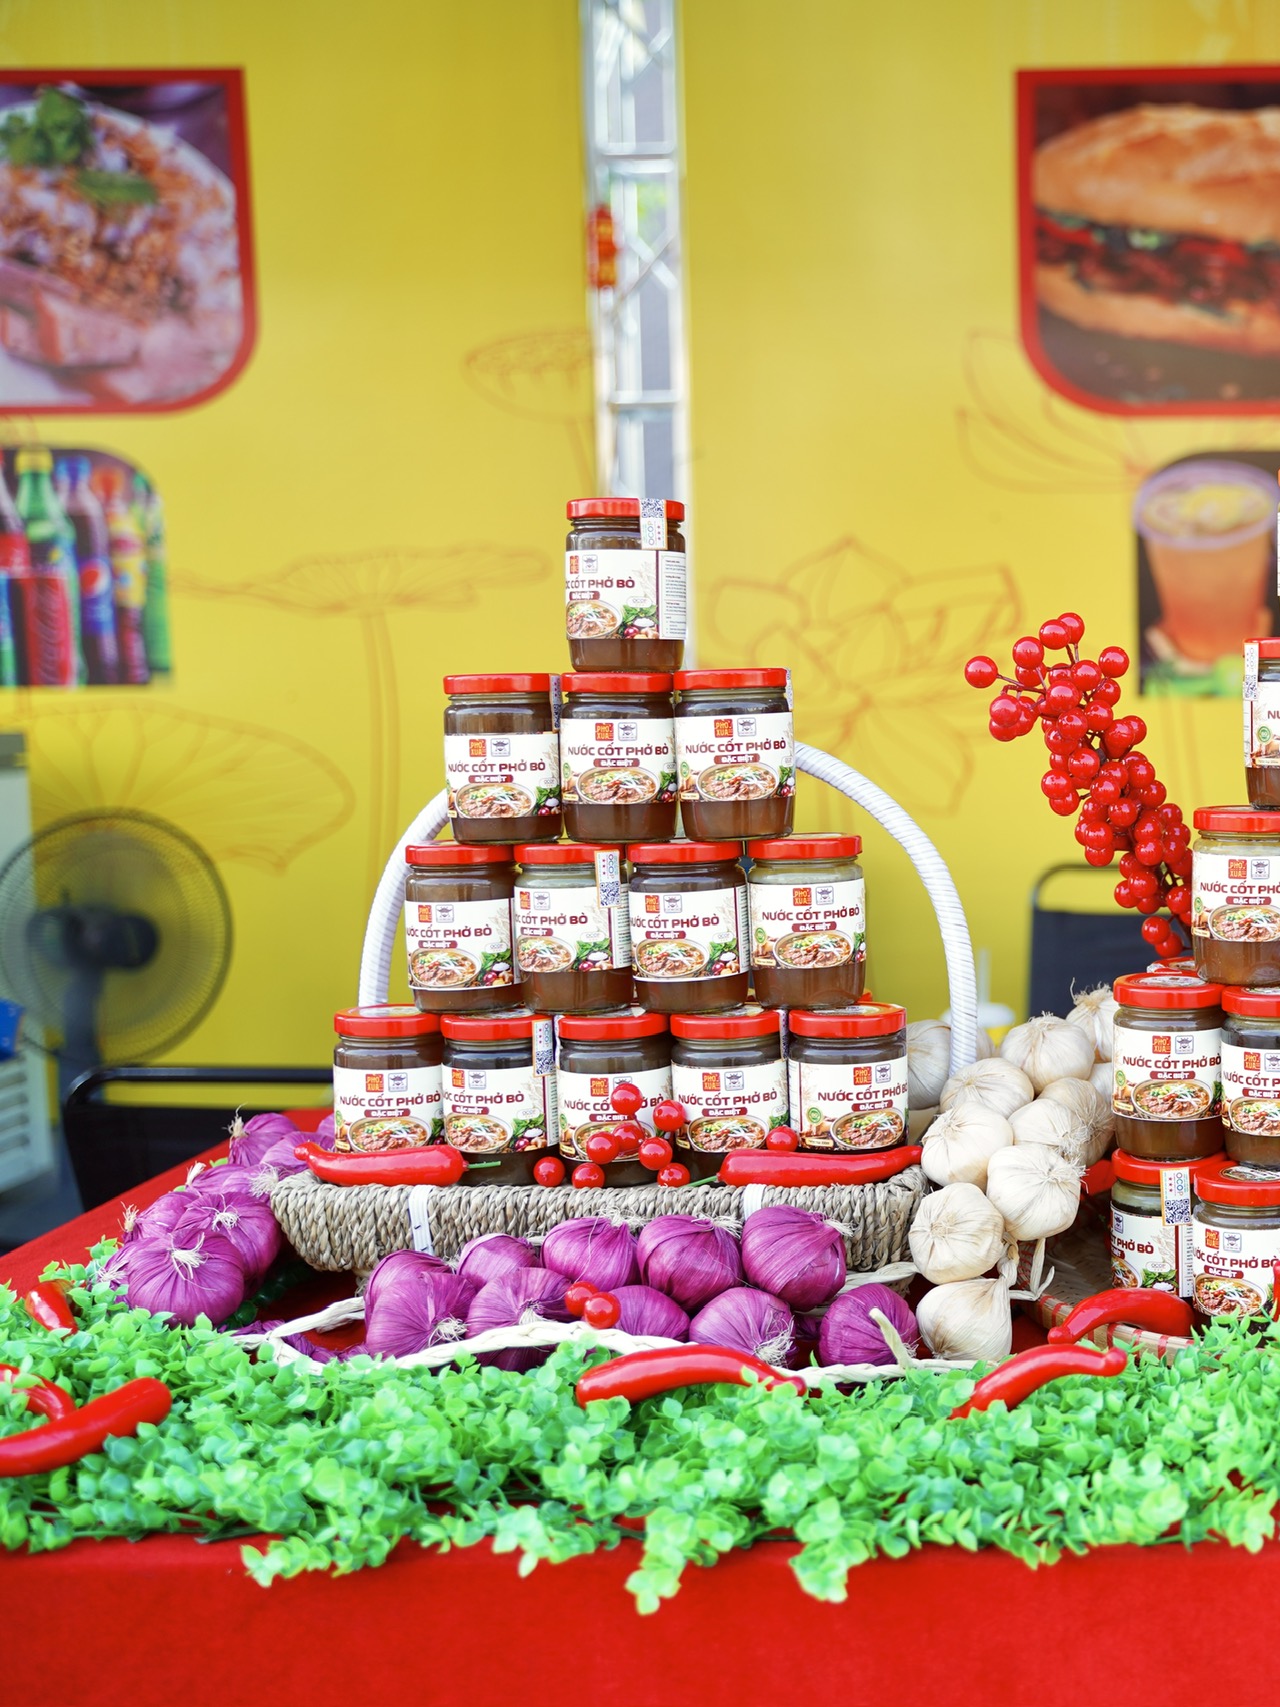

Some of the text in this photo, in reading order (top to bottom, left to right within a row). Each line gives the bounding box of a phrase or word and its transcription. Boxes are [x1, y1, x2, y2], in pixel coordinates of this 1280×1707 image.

[588, 577, 614, 588] PHỞ
[616, 576, 635, 588] BÒ
[568, 742, 668, 756] NƯỚC CỐT PHỞ BÒ
[686, 737, 786, 754] NƯỚC CỐT PHỞ BÒ
[472, 758, 496, 772] CỐT
[499, 759, 527, 772] PHỞ
[530, 758, 546, 770] BÒ
[1200, 881, 1227, 894] NƯỚC
[1230, 880, 1255, 894] CỐT
[540, 913, 567, 925] PHỞ
[569, 912, 588, 925] BÒ
[762, 904, 860, 921] NƯỚC CỐT PHỞ BÒ
[648, 914, 668, 928] CỐT
[672, 915, 699, 928] PHỞ
[702, 913, 719, 926] BÒ
[407, 924, 492, 938] ƯỚC CỐT PHỞ BÒ
[1123, 1055, 1152, 1068] NƯỚC
[1155, 1054, 1179, 1069] CỐT
[1182, 1057, 1208, 1069] PHỞ
[1246, 1072, 1269, 1087] CỐT
[340, 1090, 440, 1107] NƯỚC CỐT PHỞ BÒ
[454, 1089, 524, 1104] CỐT PHỞ BÒ
[678, 1088, 777, 1106] NƯỚC CỐT PHỞ BÒ
[818, 1089, 853, 1101] NƯỚC
[856, 1085, 880, 1099] CỐT
[882, 1083, 901, 1098] PHỞ
[564, 1094, 612, 1111] NƯỚC CỐ
[1117, 1239, 1154, 1255] PHỞ BÒ
[1206, 1250, 1226, 1267] CỐT
[1230, 1256, 1258, 1269] PHỞ
